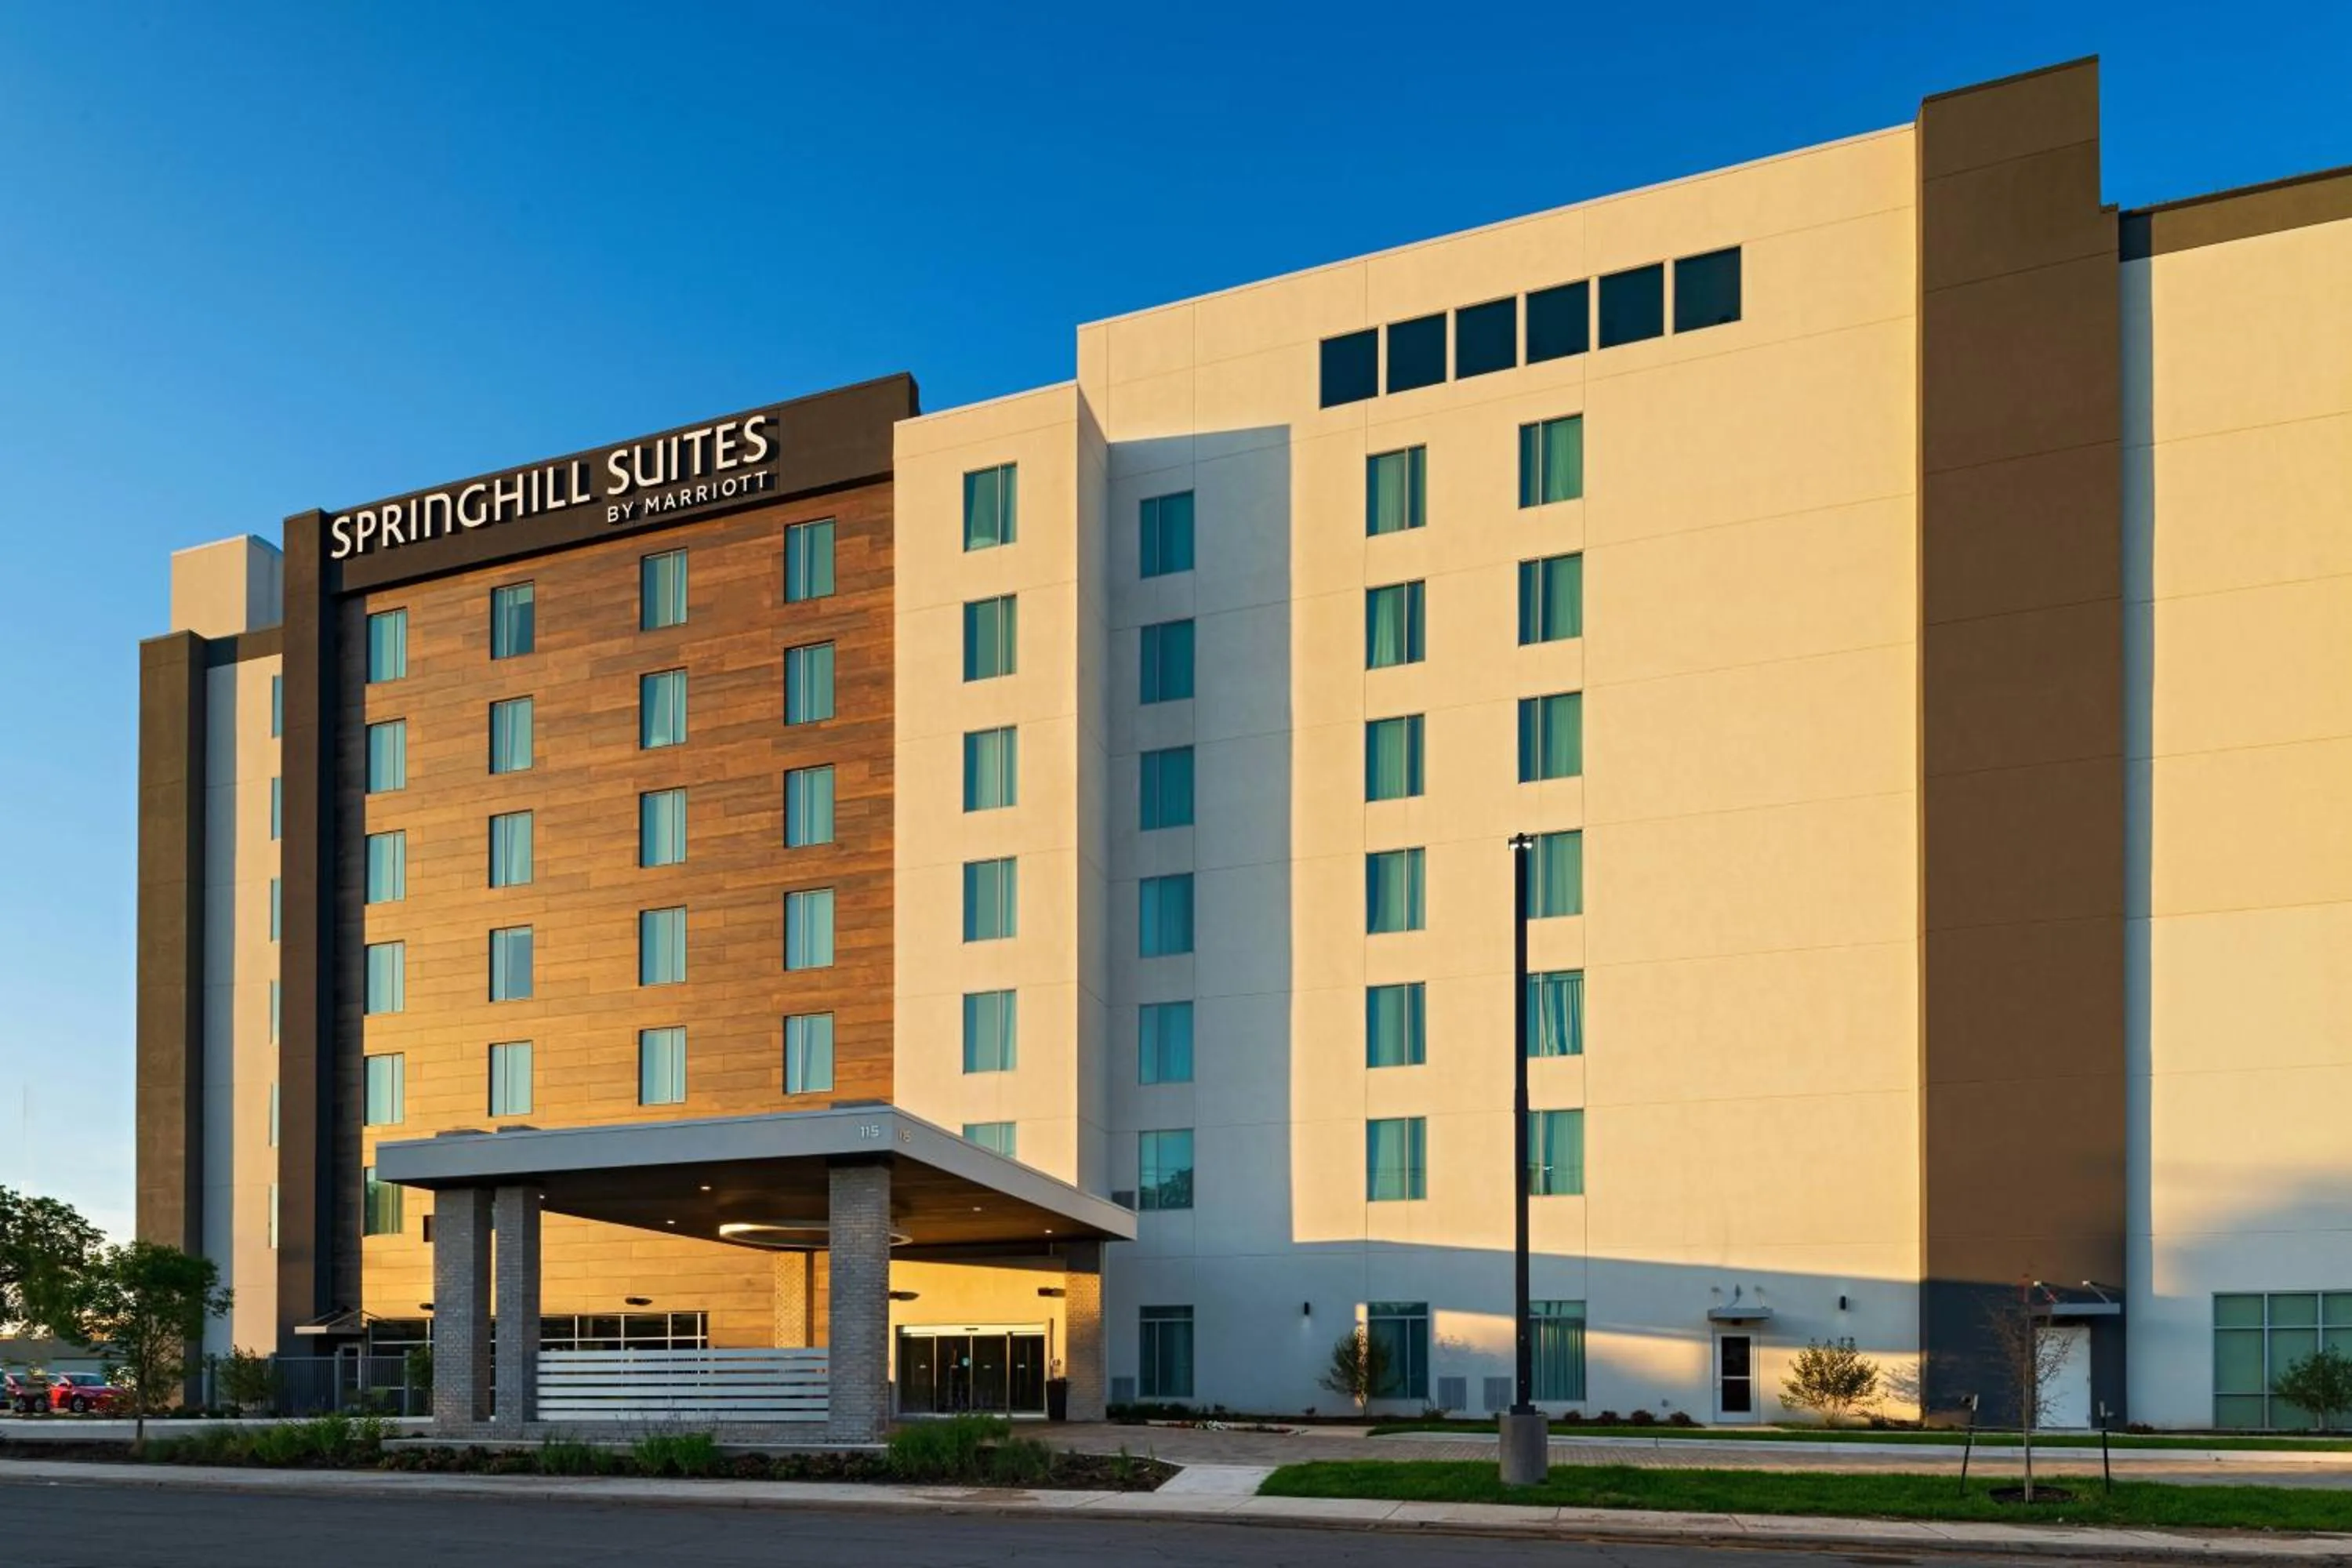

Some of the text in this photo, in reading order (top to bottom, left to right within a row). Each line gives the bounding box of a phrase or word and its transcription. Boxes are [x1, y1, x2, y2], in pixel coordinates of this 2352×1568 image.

[330, 416, 768, 559] SPRINGHILL SUITES
[607, 470, 769, 524] BY MARRIOTT
[860, 1125, 880, 1139] 115
